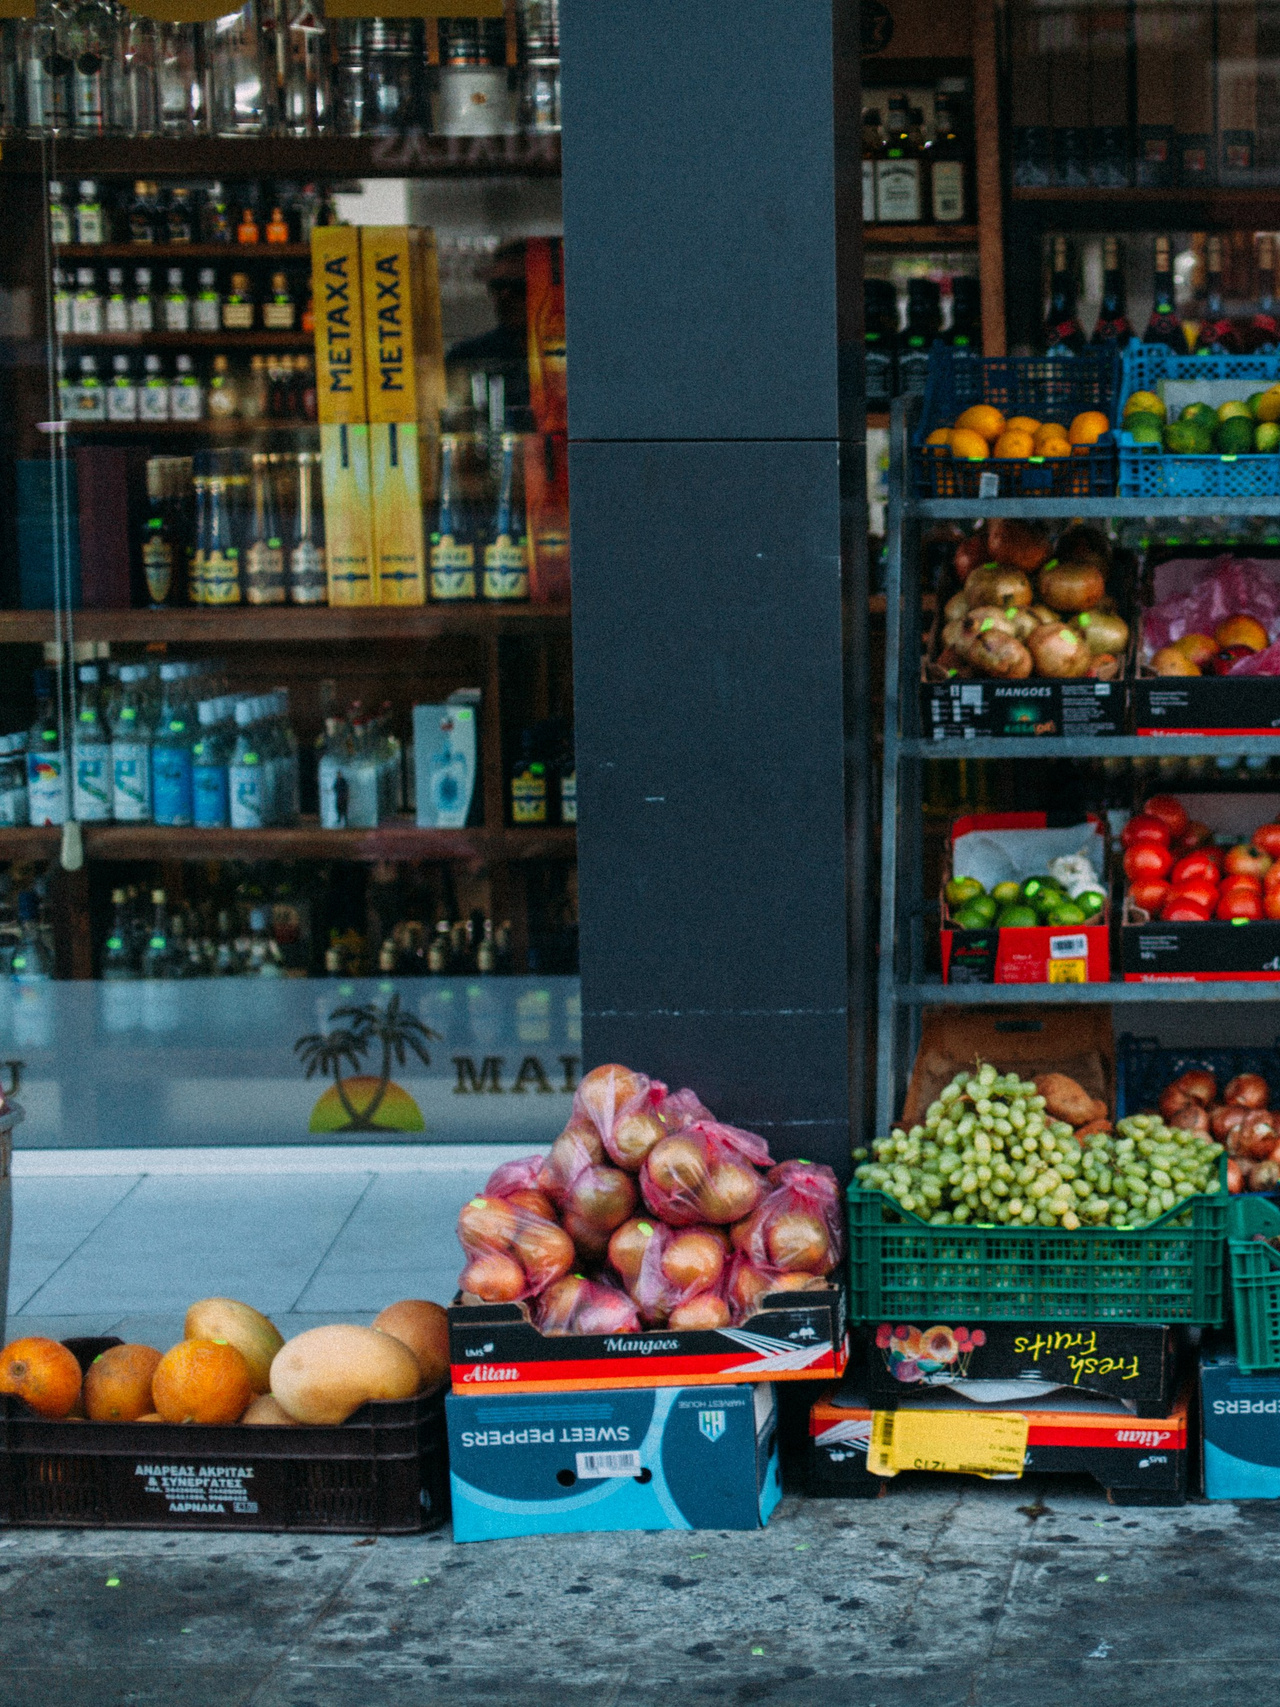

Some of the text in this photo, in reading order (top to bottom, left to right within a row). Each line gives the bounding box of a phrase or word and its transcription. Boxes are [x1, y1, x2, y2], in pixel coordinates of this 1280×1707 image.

[325, 255, 353, 392] METAXA
[376, 254, 405, 392] METAXA
[995, 687, 1053, 696] MANGOES
[603, 1336, 680, 1354] Mangoes
[1014, 1330, 1098, 1361] Fruits
[463, 1365, 520, 1383] Aitan
[1067, 1354, 1140, 1384] Fresh
[461, 1426, 631, 1447] SWEET PEPPERS
[1116, 1428, 1172, 1447] Aitan
[134, 1465, 254, 1478] ΑΝΔΡΕΑΣ ΑΚΡΙΤΑΣ
[148, 1477, 243, 1488] & ΣΥΝΕΡΓΑΤΕΣ
[169, 1502, 225, 1513] ΛΑΡΝΑΚΑ
